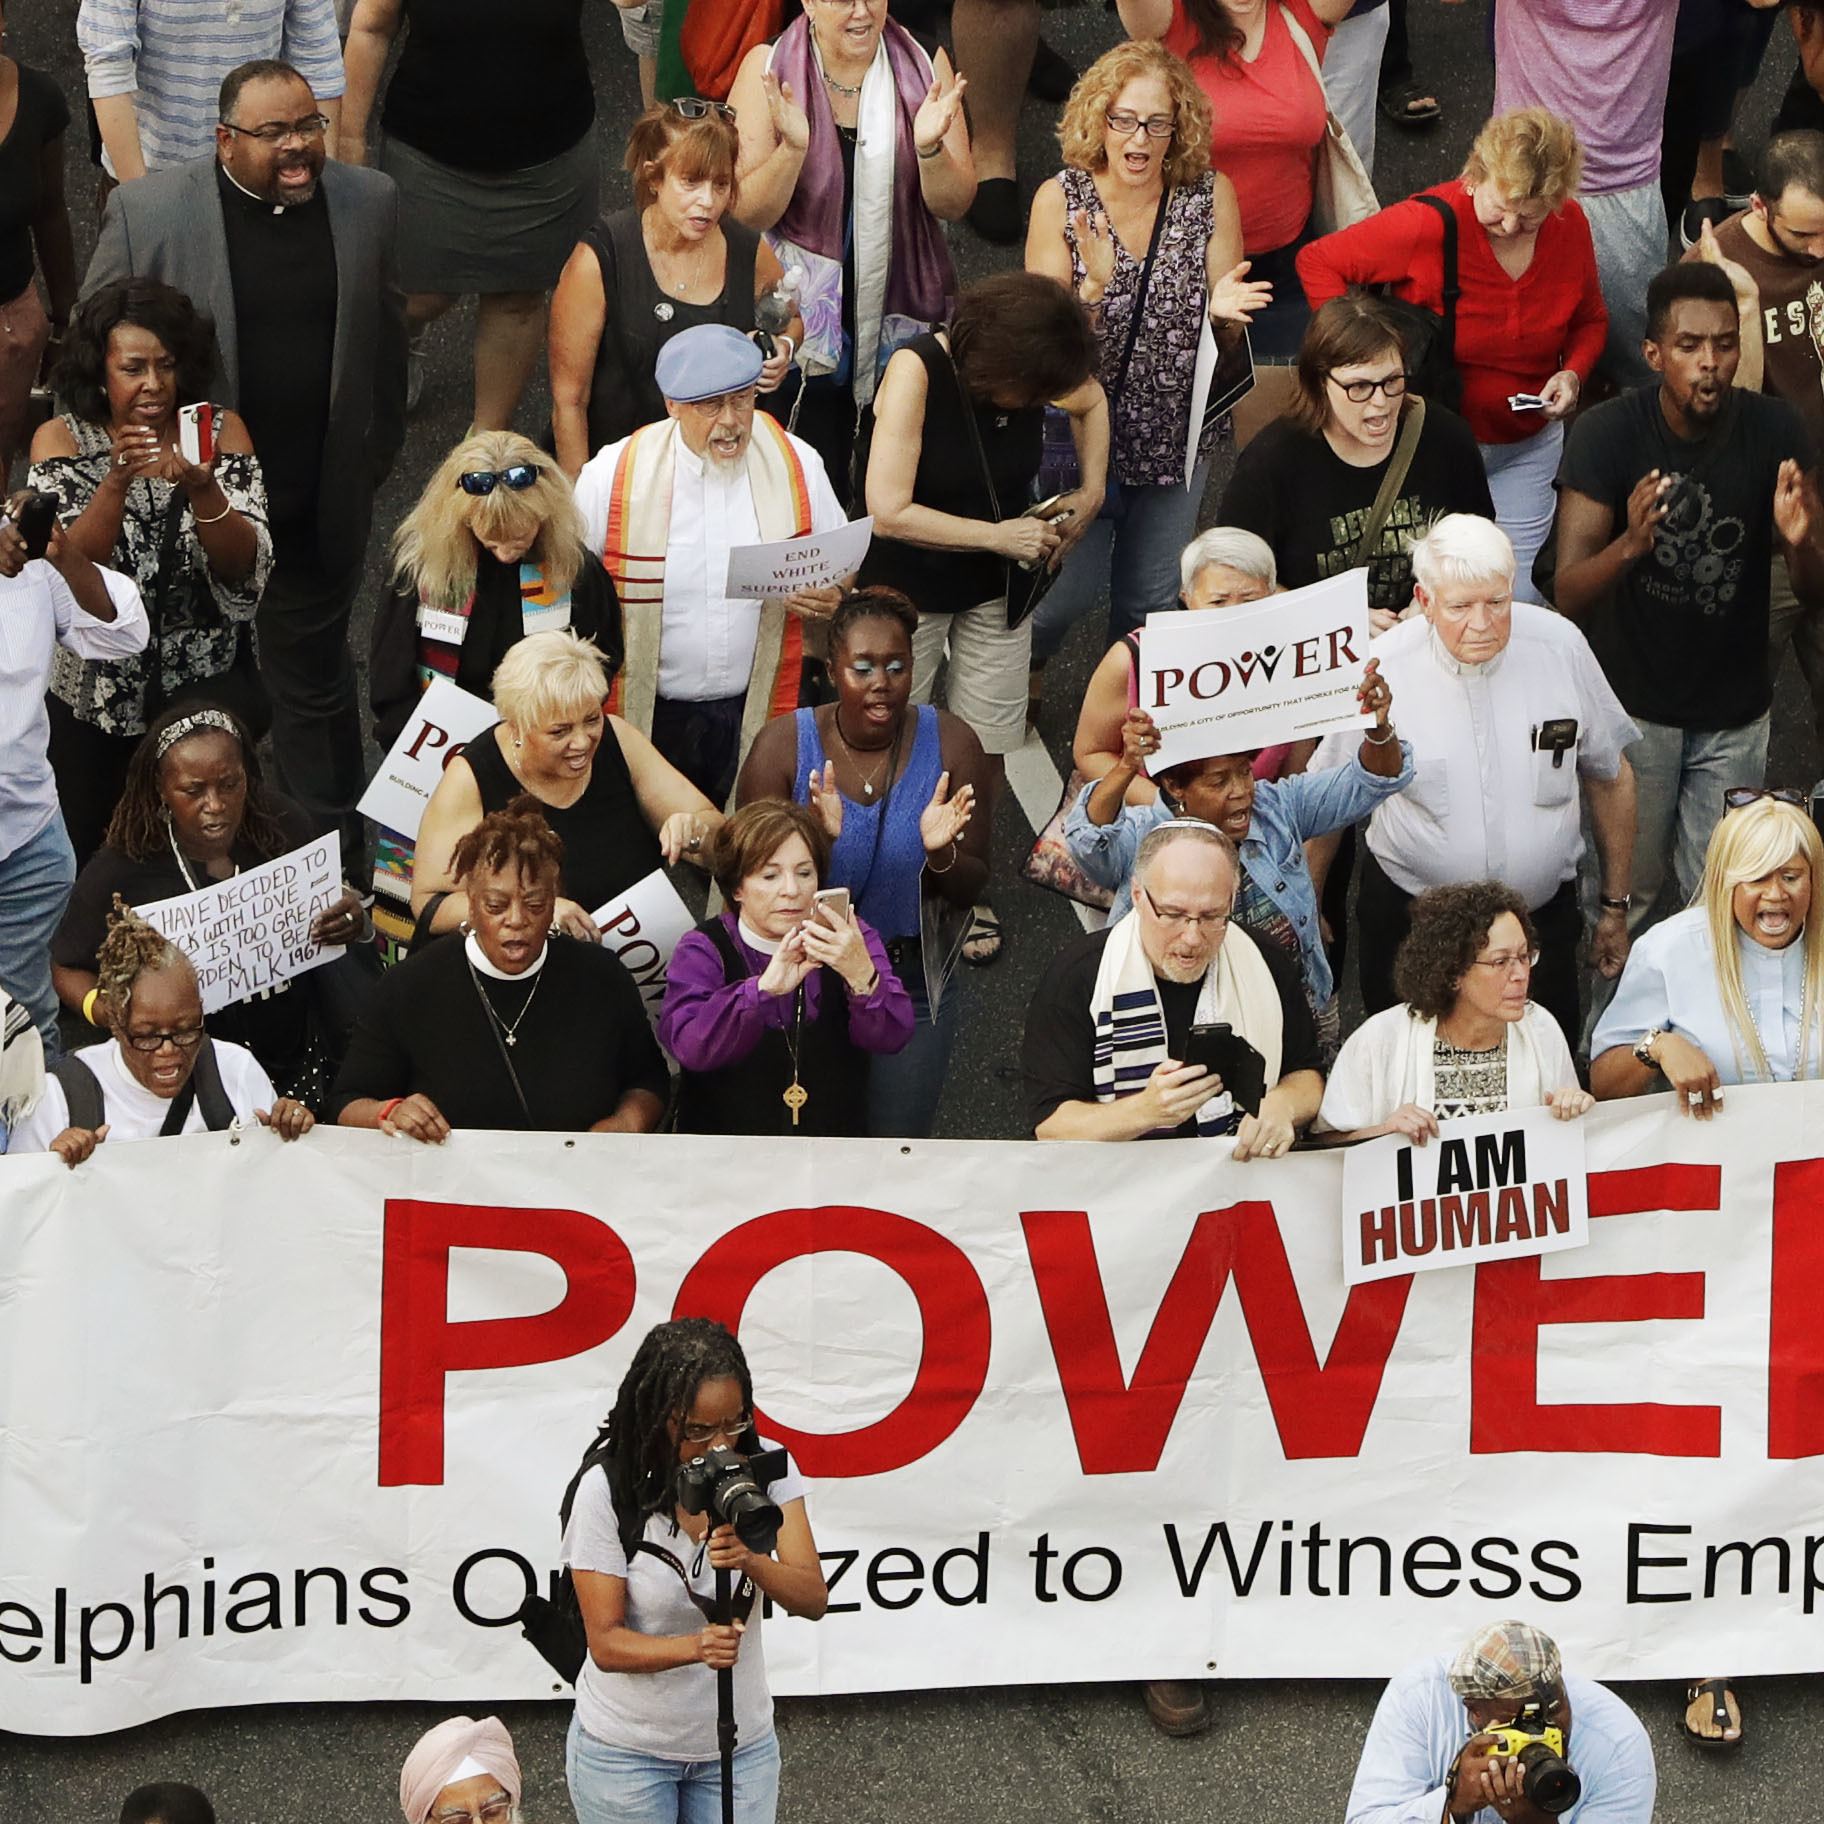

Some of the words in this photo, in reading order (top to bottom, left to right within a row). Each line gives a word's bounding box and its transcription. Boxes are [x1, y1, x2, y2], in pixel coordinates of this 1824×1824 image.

[740, 568, 852, 595] SUPREMACY
[771, 561, 833, 581] WHITE
[784, 547, 822, 563] END
[1150, 624, 1362, 709] POWER
[159, 896, 211, 936] HAVE
[217, 864, 298, 913] DECIDED
[302, 847, 328, 874] TO
[204, 913, 245, 942] WITH
[252, 888, 300, 921] LOVE
[207, 942, 231, 962] IS
[233, 922, 267, 948] TOO
[271, 886, 336, 934] GREAT
[227, 953, 285, 999] MLK
[288, 940, 323, 968] 1967
[251, 940, 274, 964] TO
[1395, 1144, 1415, 1203] I
[1435, 1128, 1528, 1197] AM
[1359, 1178, 1571, 1267] HUMAN
[1029, 1531, 1124, 1605] to
[1162, 1517, 1582, 1604] Witness
